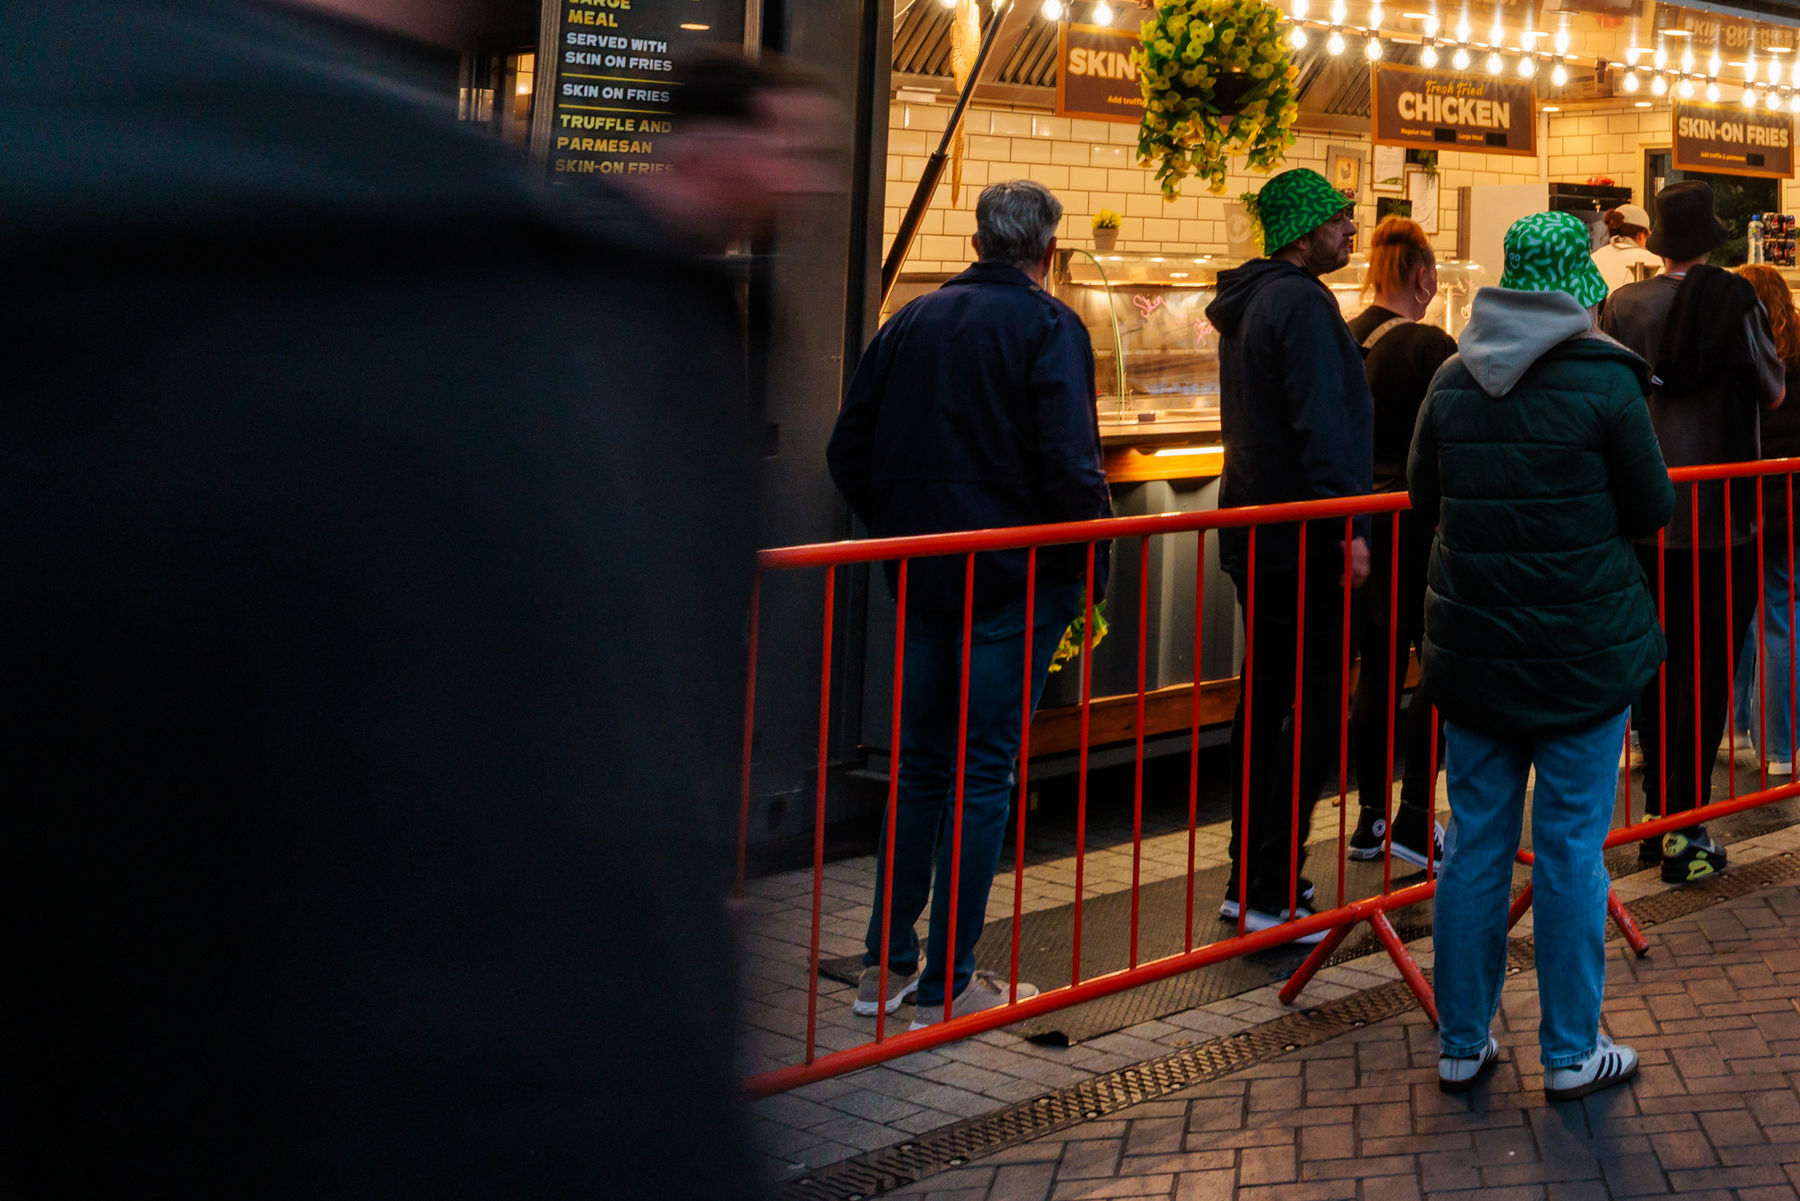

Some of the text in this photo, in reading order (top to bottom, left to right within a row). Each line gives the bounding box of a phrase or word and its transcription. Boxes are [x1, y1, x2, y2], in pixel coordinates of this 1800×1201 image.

[567, 9, 619, 28] MEAL
[566, 31, 668, 53] SERVED WITH
[565, 51, 673, 72] SKIN ON FRIES
[562, 83, 671, 103] SKIN ON FRIES
[1425, 80, 1484, 98] Fresh Fried
[1107, 95, 1122, 104] Add
[1398, 90, 1511, 129] CHICKEN
[559, 113, 673, 133] TRUFFLE AND
[1400, 128, 1420, 137] Regular
[1678, 116, 1789, 149] SKIN-ON FRIES
[556, 136, 653, 154] PARMESAN
[554, 158, 625, 175] SKIN-ON
